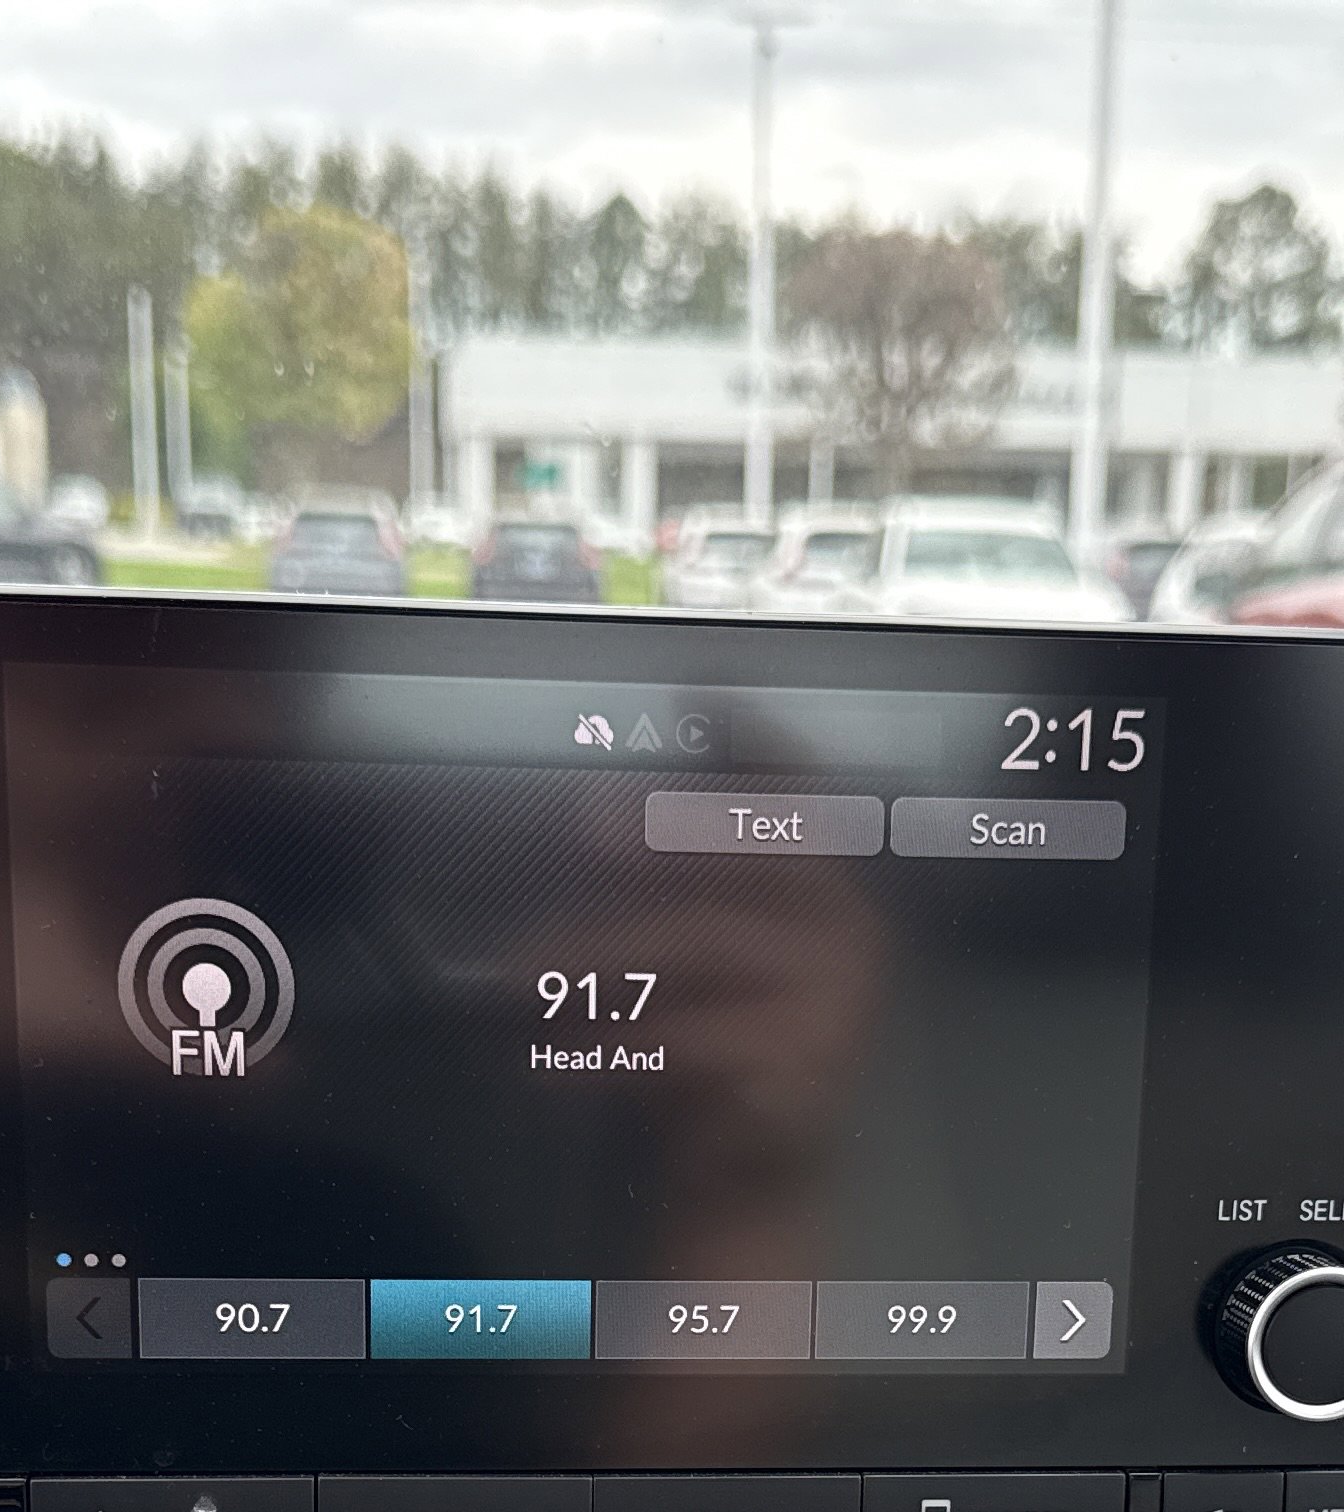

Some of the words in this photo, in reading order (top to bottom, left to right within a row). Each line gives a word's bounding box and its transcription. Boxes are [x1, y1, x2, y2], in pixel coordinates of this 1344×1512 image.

[1000, 706, 1145, 772] 2:15
[728, 808, 803, 841] Text
[970, 812, 1046, 845] Scan
[537, 970, 657, 1021] 91.7
[171, 1029, 245, 1076] FM
[531, 1044, 602, 1070] Head
[609, 1045, 664, 1071] And
[1218, 1199, 1268, 1222] LIST
[215, 1303, 291, 1333] 90.7
[444, 1303, 517, 1333] 91.7
[668, 1304, 740, 1334] 95.7
[887, 1305, 957, 1334] 99.9
